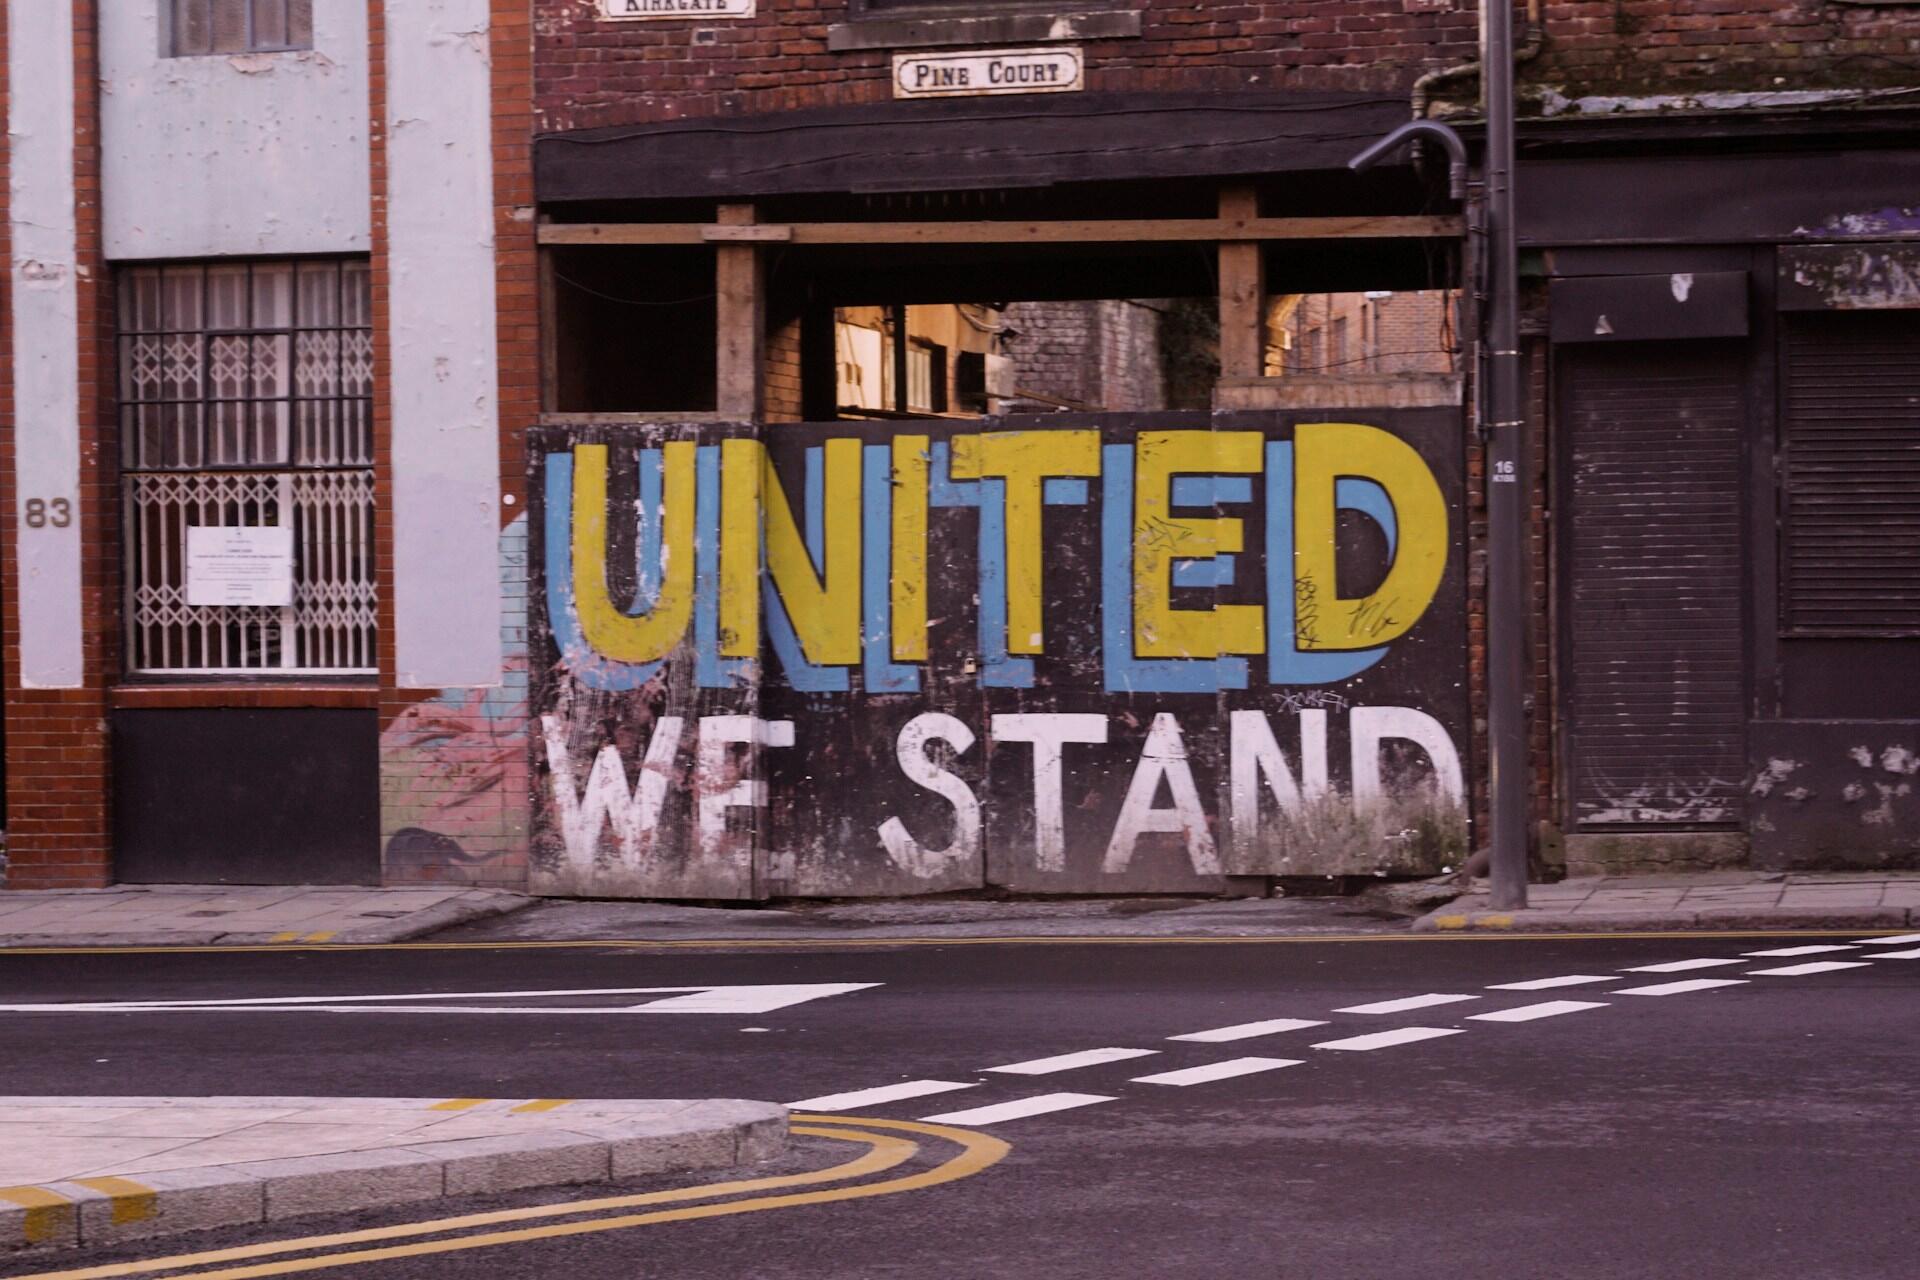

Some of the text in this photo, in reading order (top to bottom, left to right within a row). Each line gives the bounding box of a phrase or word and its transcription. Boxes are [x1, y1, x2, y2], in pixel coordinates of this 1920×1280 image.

[916, 61, 1059, 87] PINE COURT
[1495, 460, 1514, 474] 16
[26, 497, 71, 528] 83
[545, 423, 1449, 692] UNITED
[541, 706, 1466, 879] WE STAND
